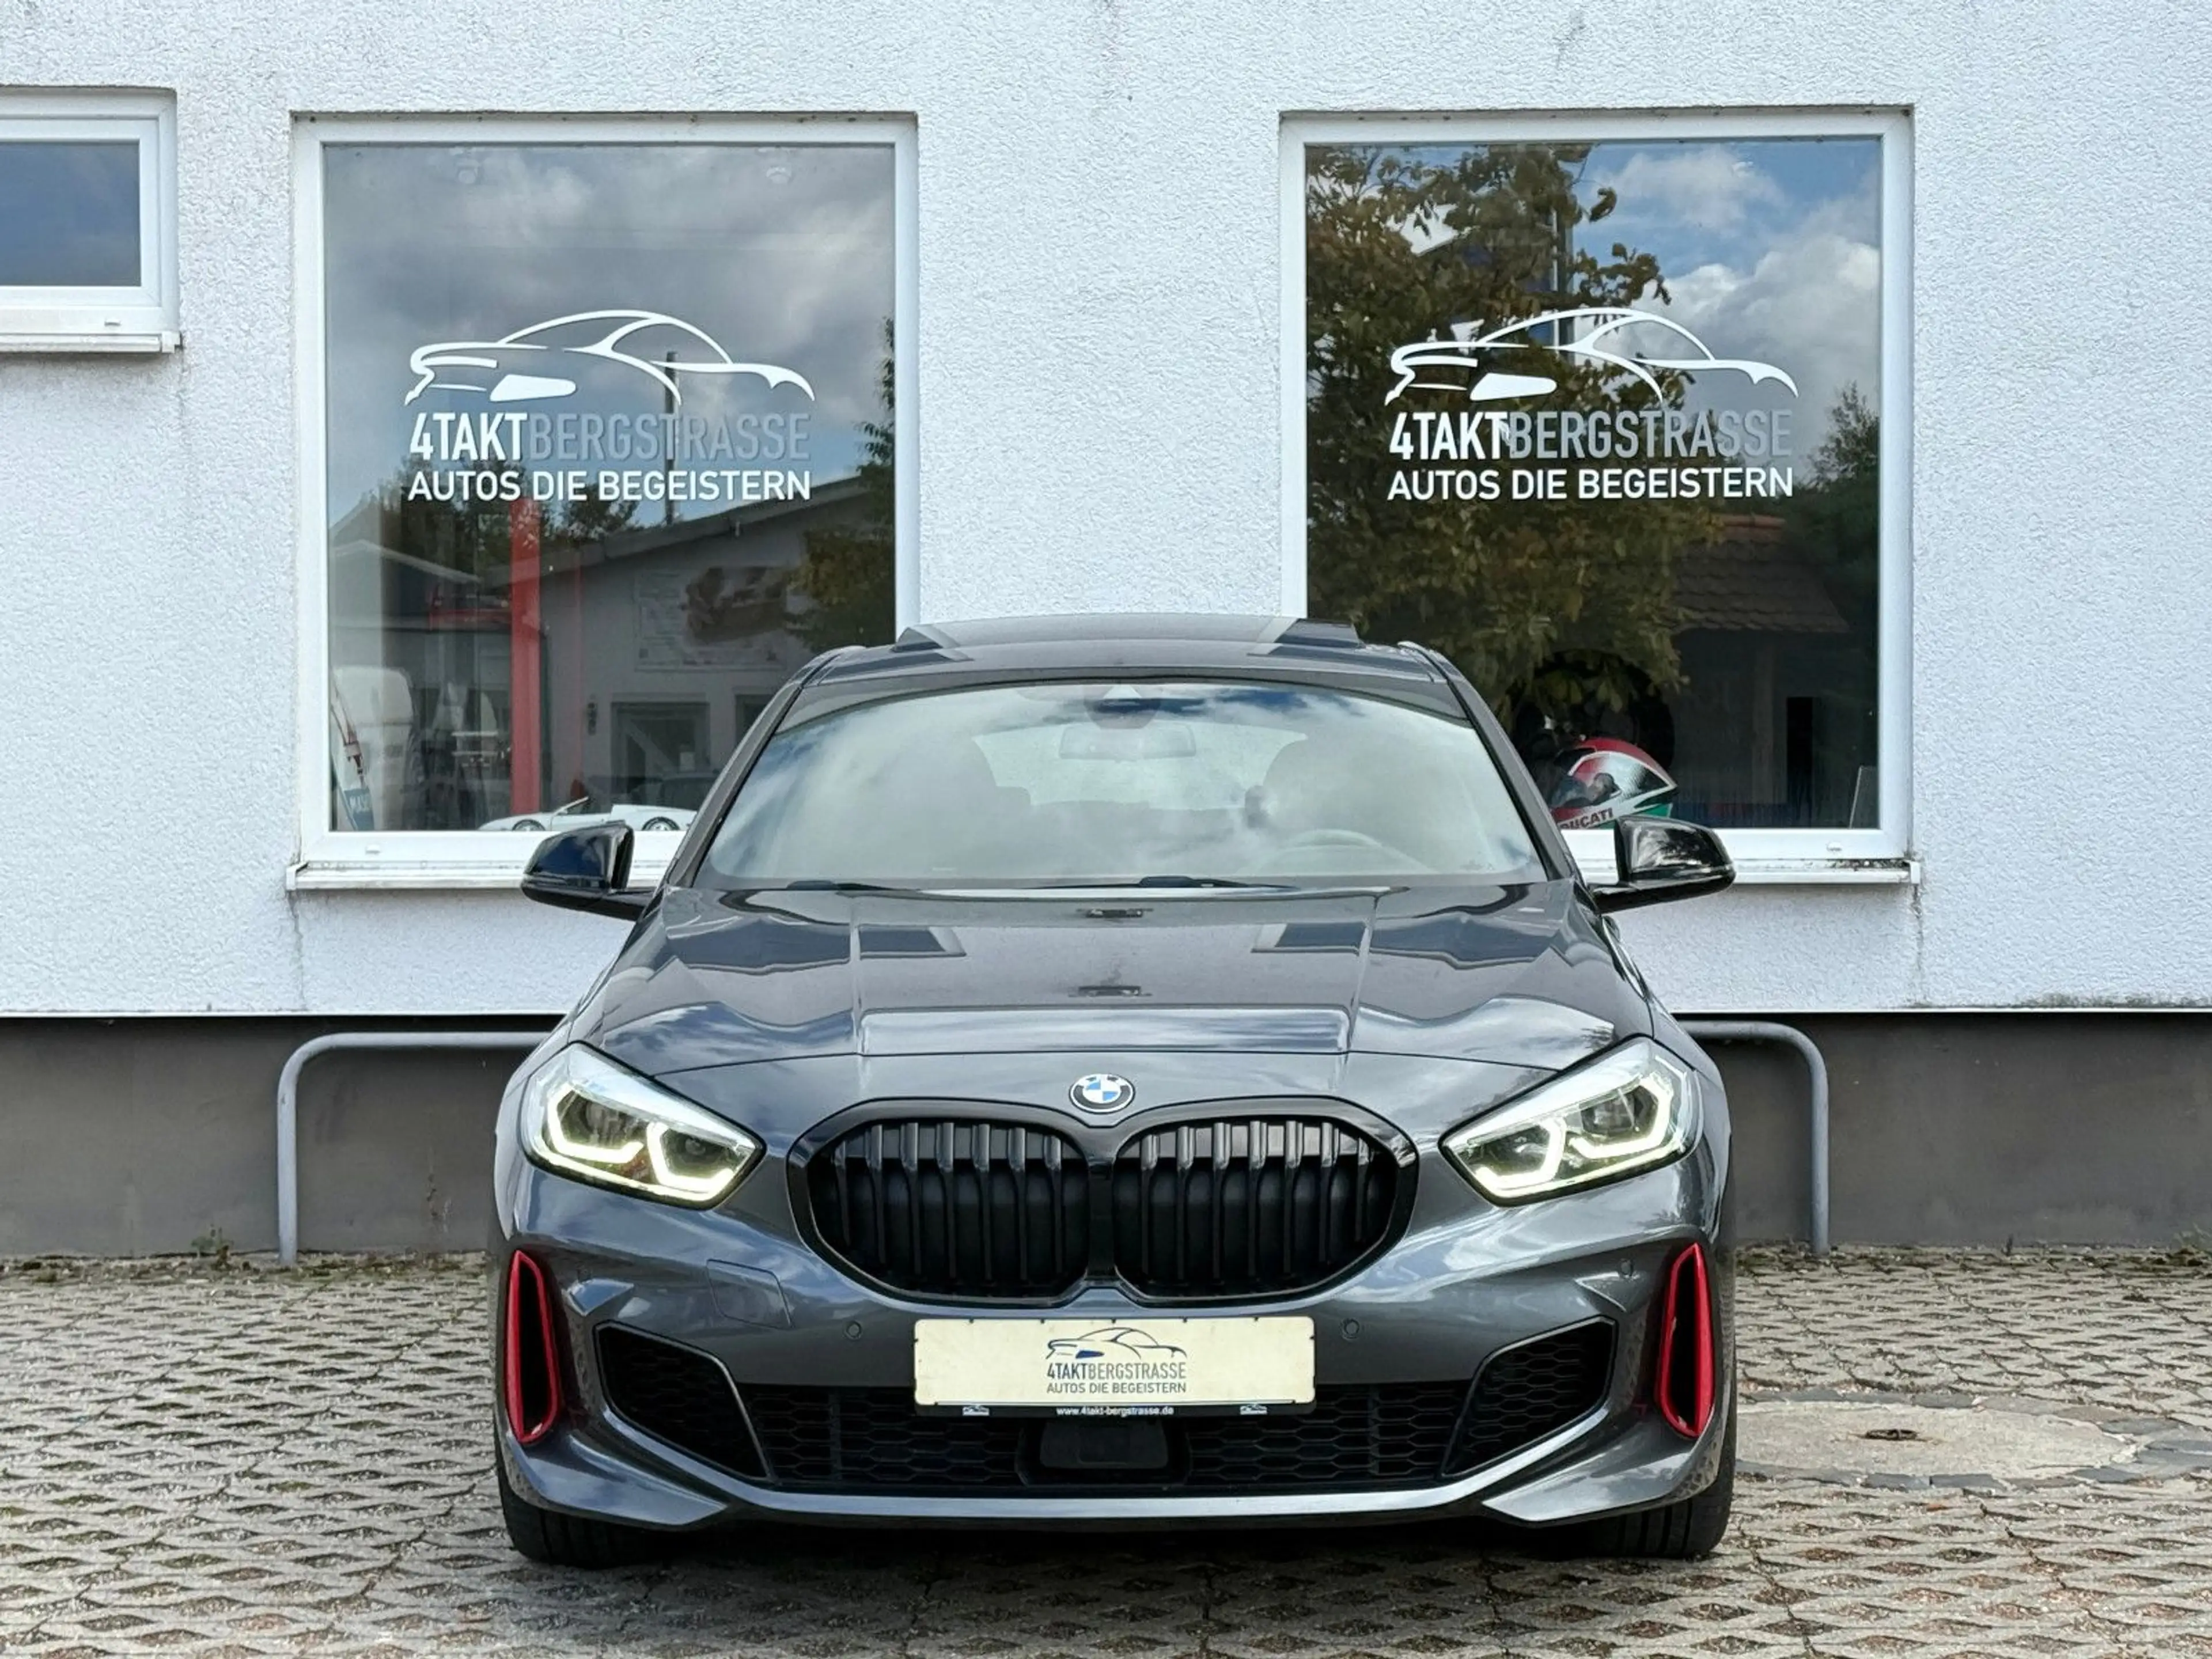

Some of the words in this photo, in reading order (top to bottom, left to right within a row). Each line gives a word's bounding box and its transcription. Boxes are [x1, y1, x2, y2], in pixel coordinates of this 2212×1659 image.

[410, 412, 810, 461] 4TAKTBERGSTRASSE
[1389, 411, 1793, 460] 4TAKTBERGSTRASSE
[408, 471, 521, 501] AUTOS
[534, 471, 586, 501] DIE
[600, 470, 810, 501] BEGEISTERN
[1388, 469, 1500, 500] AUTOS
[1512, 468, 1567, 499] DIE
[1580, 467, 1793, 499] BEGEISTERN
[1047, 1362, 1187, 1380] 4TAKTBERGSTRASSE
[1047, 1382, 1085, 1393] AUTOS
[1089, 1382, 1109, 1393] DIE
[1112, 1382, 1187, 1393] BEGEISTERN
[1056, 1406, 1174, 1417] www.4takt-bergstrasse.de
